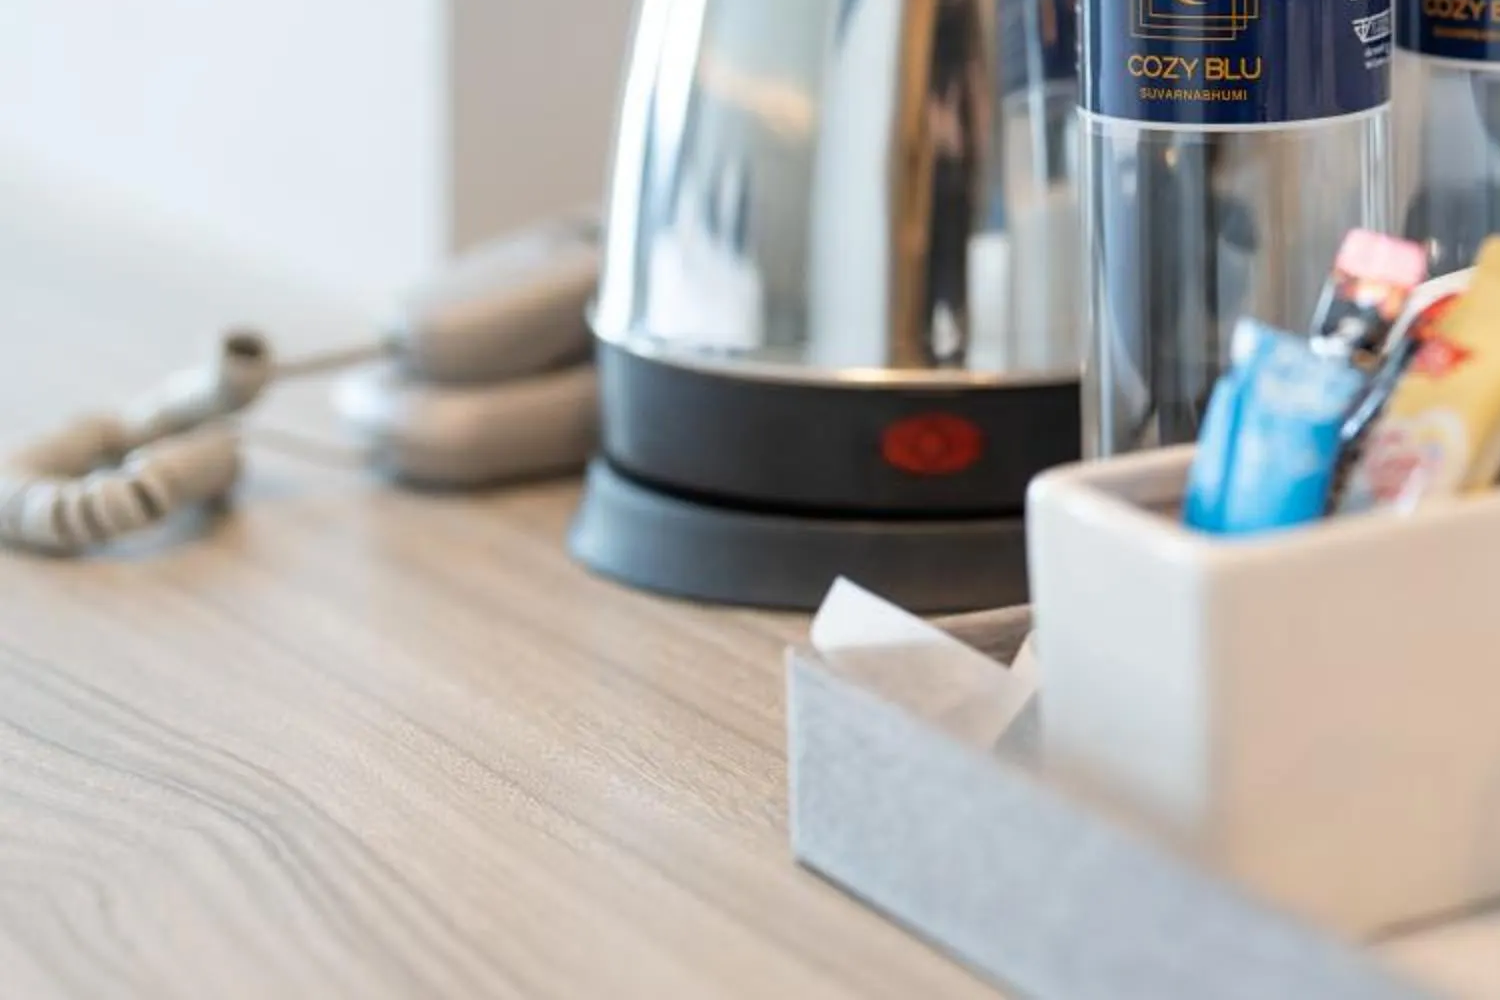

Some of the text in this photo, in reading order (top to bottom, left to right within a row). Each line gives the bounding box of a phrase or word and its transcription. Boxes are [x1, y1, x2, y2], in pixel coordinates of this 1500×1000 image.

[1127, 55, 1262, 80] COZY BLU
[1139, 87, 1247, 101] SUVARNABHUMI
